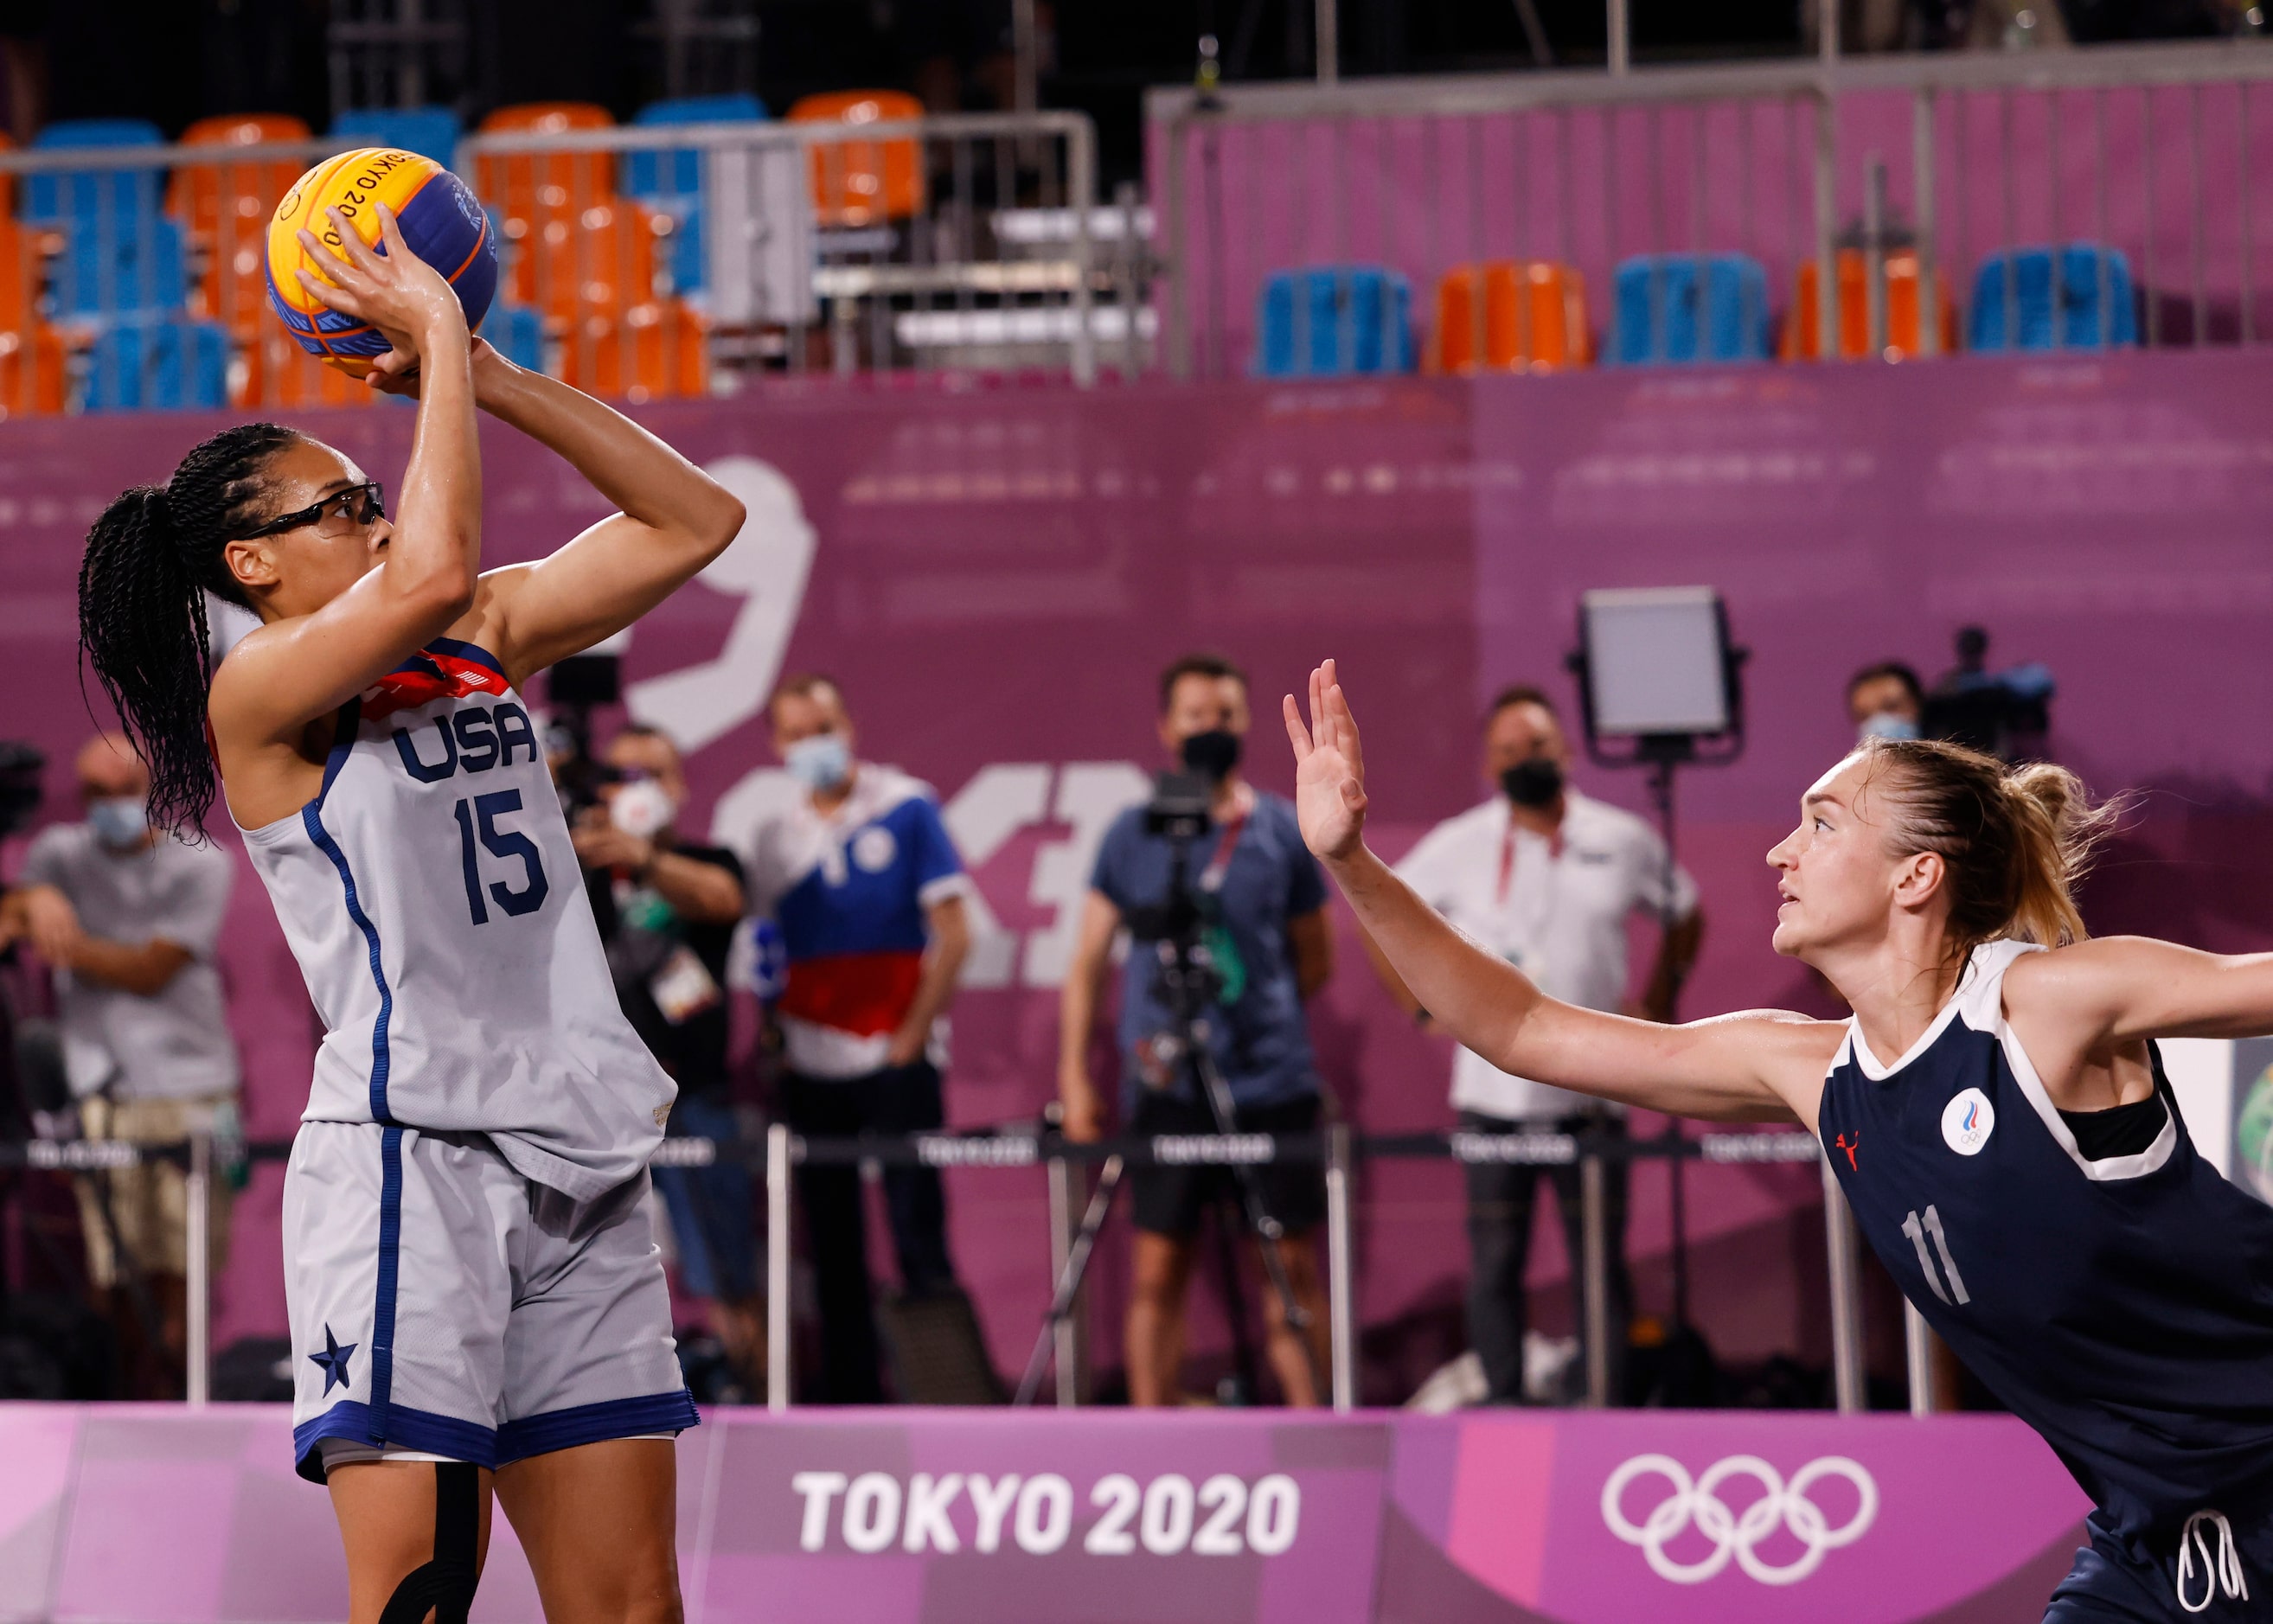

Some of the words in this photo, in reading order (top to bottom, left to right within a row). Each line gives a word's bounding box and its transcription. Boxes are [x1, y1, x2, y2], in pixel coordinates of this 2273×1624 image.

[323, 190, 366, 247] 200
[393, 702, 537, 784] USA
[454, 788, 549, 926] 15
[1901, 1204, 1971, 1306] 11
[791, 1471, 1073, 1554] TOKYO
[1083, 1473, 1301, 1556] 2020
